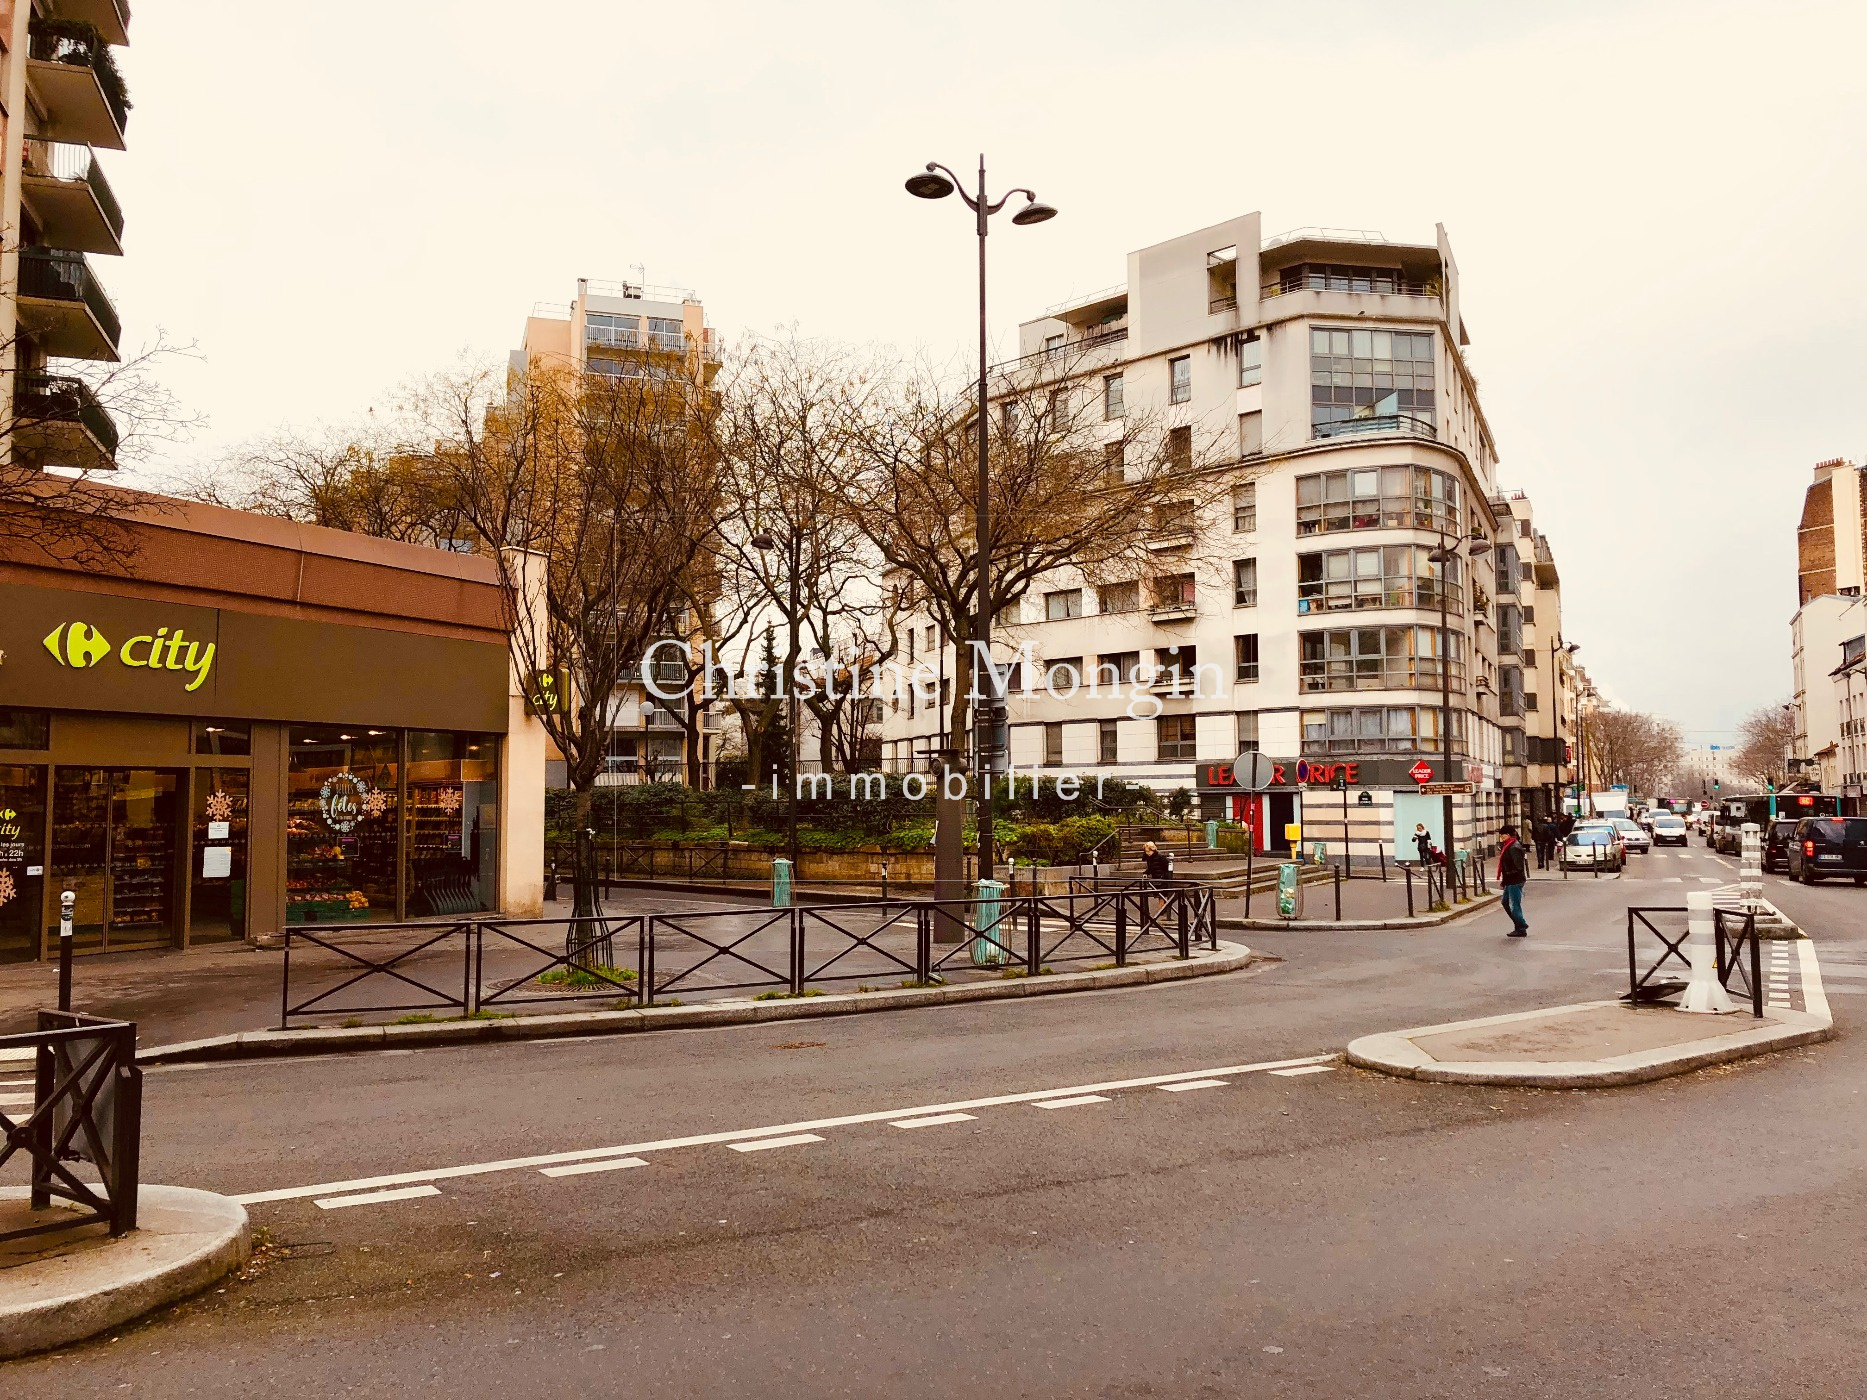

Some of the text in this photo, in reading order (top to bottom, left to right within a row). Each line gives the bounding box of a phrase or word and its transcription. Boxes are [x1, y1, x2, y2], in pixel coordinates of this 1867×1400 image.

[120, 627, 216, 692] city
[331, 794, 358, 818] fêtes
[0, 823, 21, 840] ity
[9, 849, 24, 857] 22h
